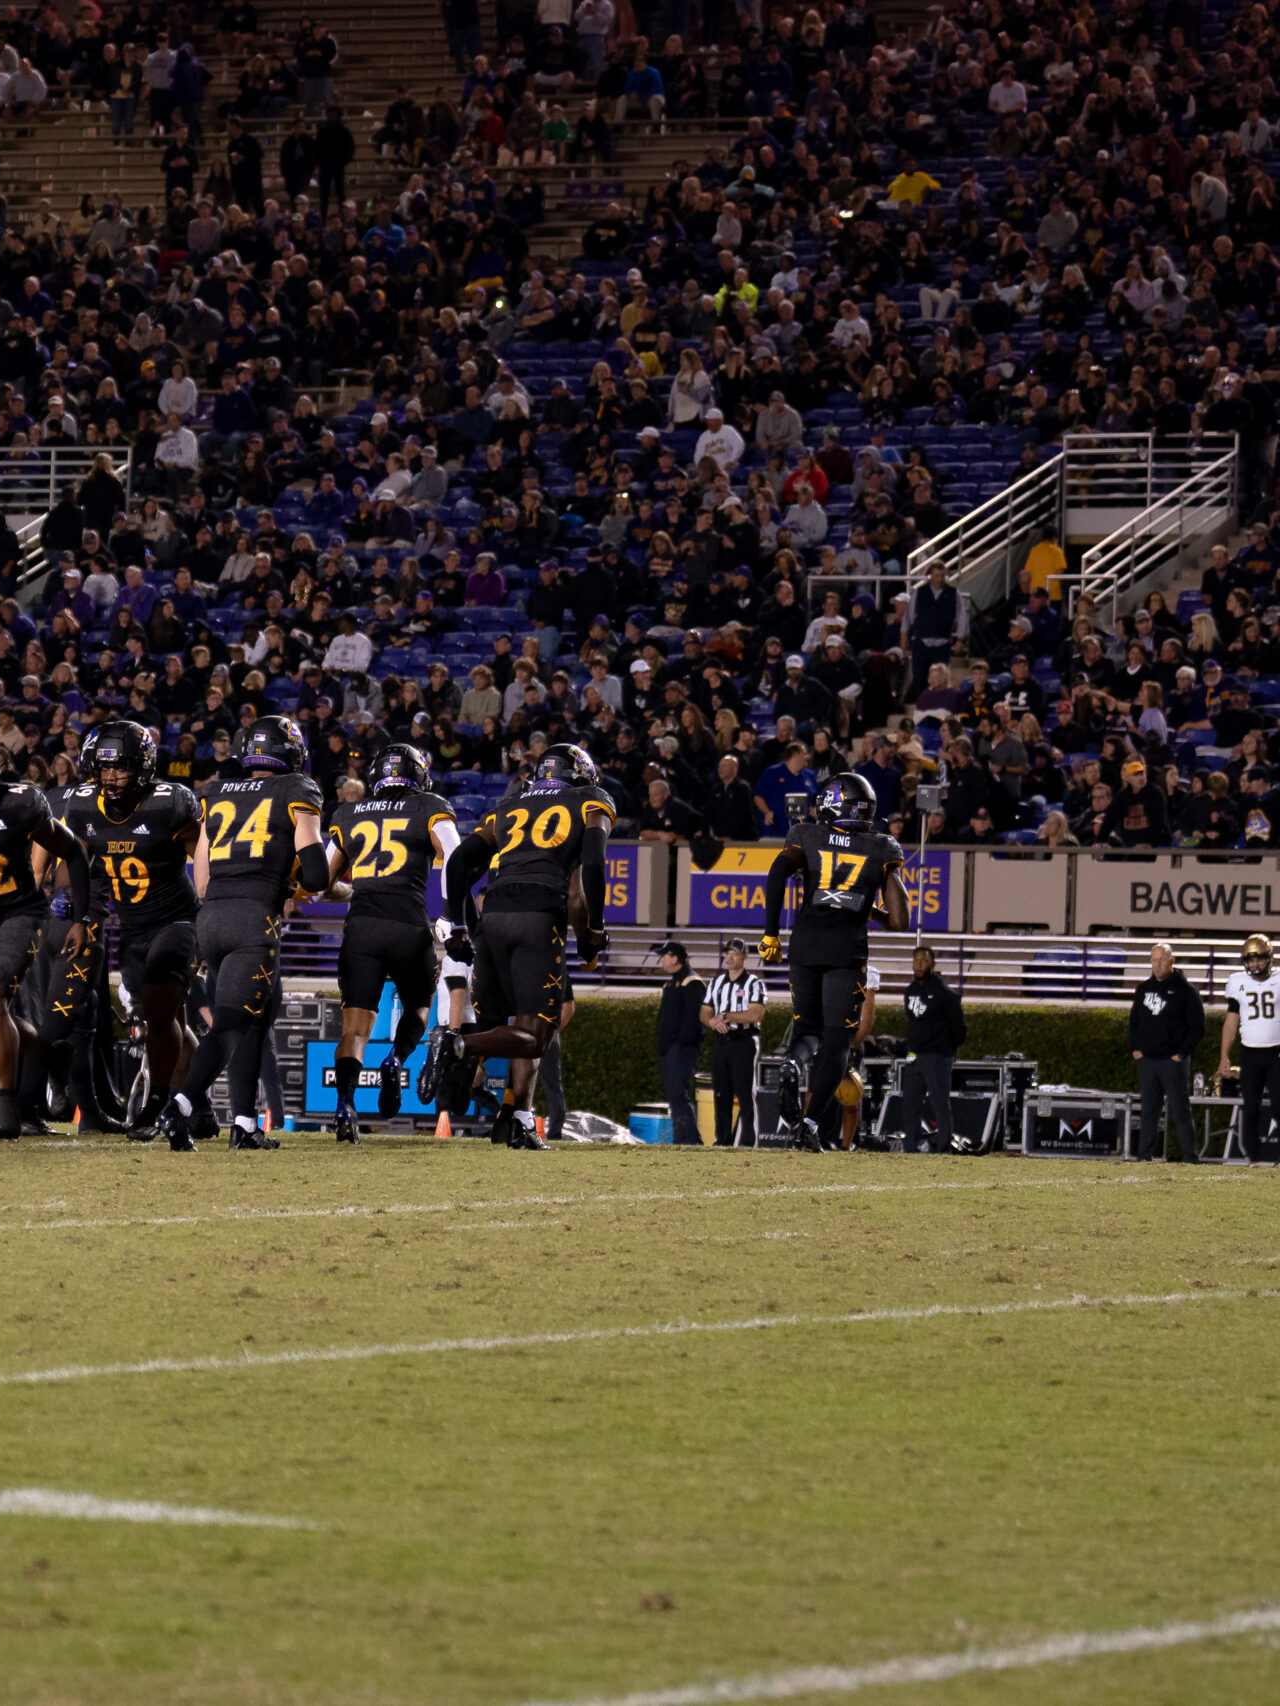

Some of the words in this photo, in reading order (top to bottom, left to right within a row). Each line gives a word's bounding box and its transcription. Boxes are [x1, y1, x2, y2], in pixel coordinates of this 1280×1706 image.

[220, 781, 264, 793] POWERS
[106, 841, 137, 854] ECU
[209, 798, 273, 861] 24
[499, 805, 571, 856] 30
[828, 833, 851, 848] KING
[350, 818, 410, 880] 25
[737, 852, 747, 867] 7
[101, 856, 151, 903] 19
[818, 848, 868, 892] 17
[1245, 990, 1275, 1020] 36
